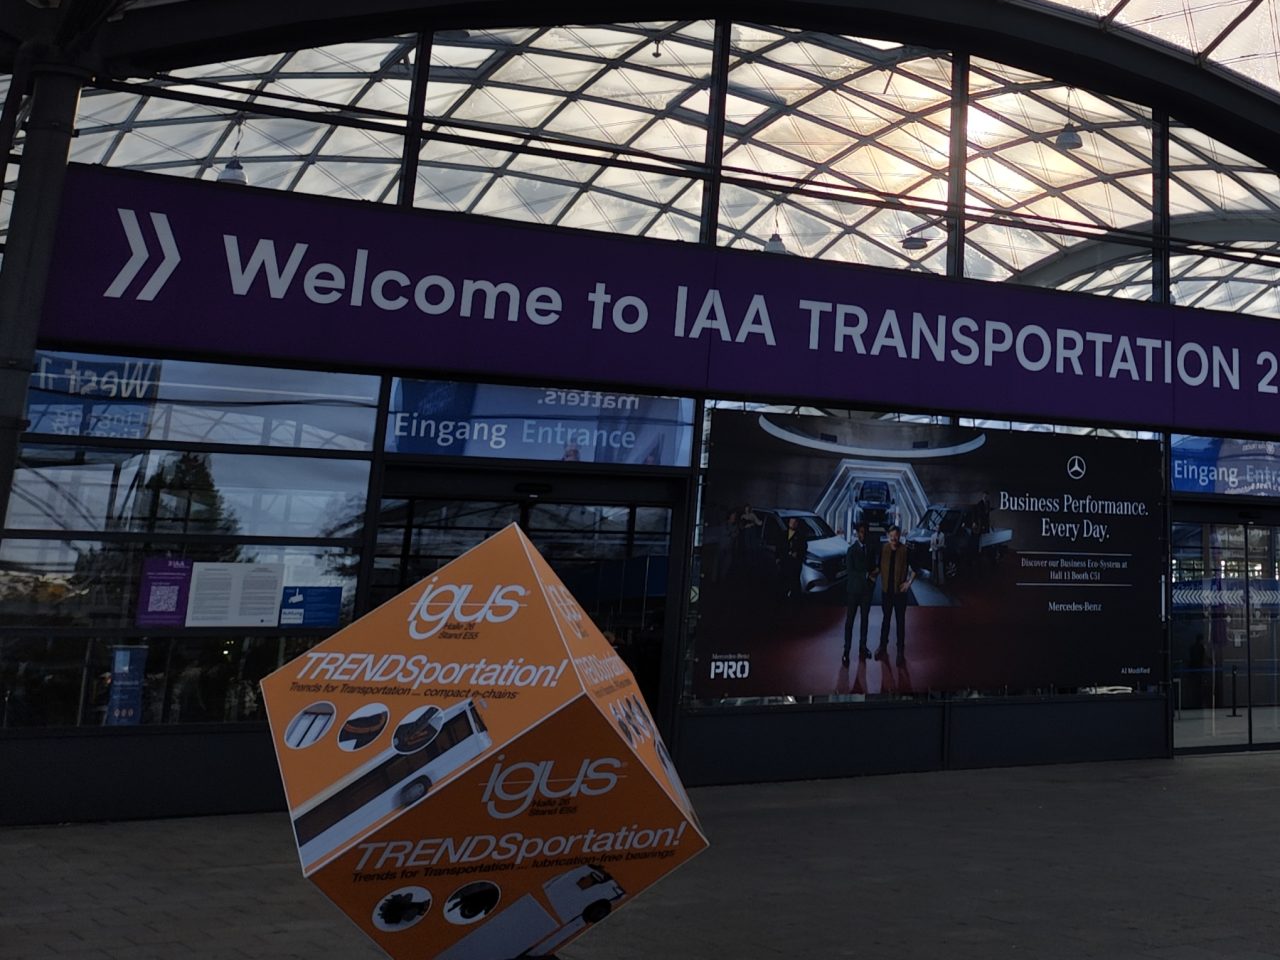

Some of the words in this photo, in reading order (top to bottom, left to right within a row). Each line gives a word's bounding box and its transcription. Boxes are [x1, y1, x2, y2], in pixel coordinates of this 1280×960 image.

[223, 234, 563, 326] Welcome
[587, 282, 649, 334] to
[674, 285, 777, 346] IAA
[799, 299, 1240, 390] TRANSPORTATION
[394, 411, 509, 449] Eingang
[522, 419, 637, 449] Entrance
[1174, 459, 1239, 487] Eingang
[1000, 490, 1060, 513] Business
[1063, 493, 1150, 517] Performance.
[1041, 517, 1081, 542] Every
[1083, 519, 1110, 543] Day.
[1021, 557, 1047, 568] Discover
[1048, 559, 1059, 568] our
[1060, 558, 1086, 569] Business
[1050, 570, 1062, 580] Hall
[1071, 571, 1089, 581] Booth
[407, 577, 529, 640] igus
[1048, 601, 1102, 612] Mercedes-Benz
[296, 651, 568, 690] TRENDSportation!
[709, 660, 751, 680] PRO
[289, 681, 322, 693] Trends
[323, 683, 339, 693] for
[339, 683, 412, 696] Transportation
[423, 688, 471, 699] compact
[480, 753, 624, 820] igus
[353, 820, 688, 871] TRENDSportation!
[352, 870, 397, 883] Trends
[400, 869, 419, 880] for
[423, 862, 515, 878] Transportation
[531, 852, 623, 869] lubrication-free
[625, 848, 675, 861] bearings
